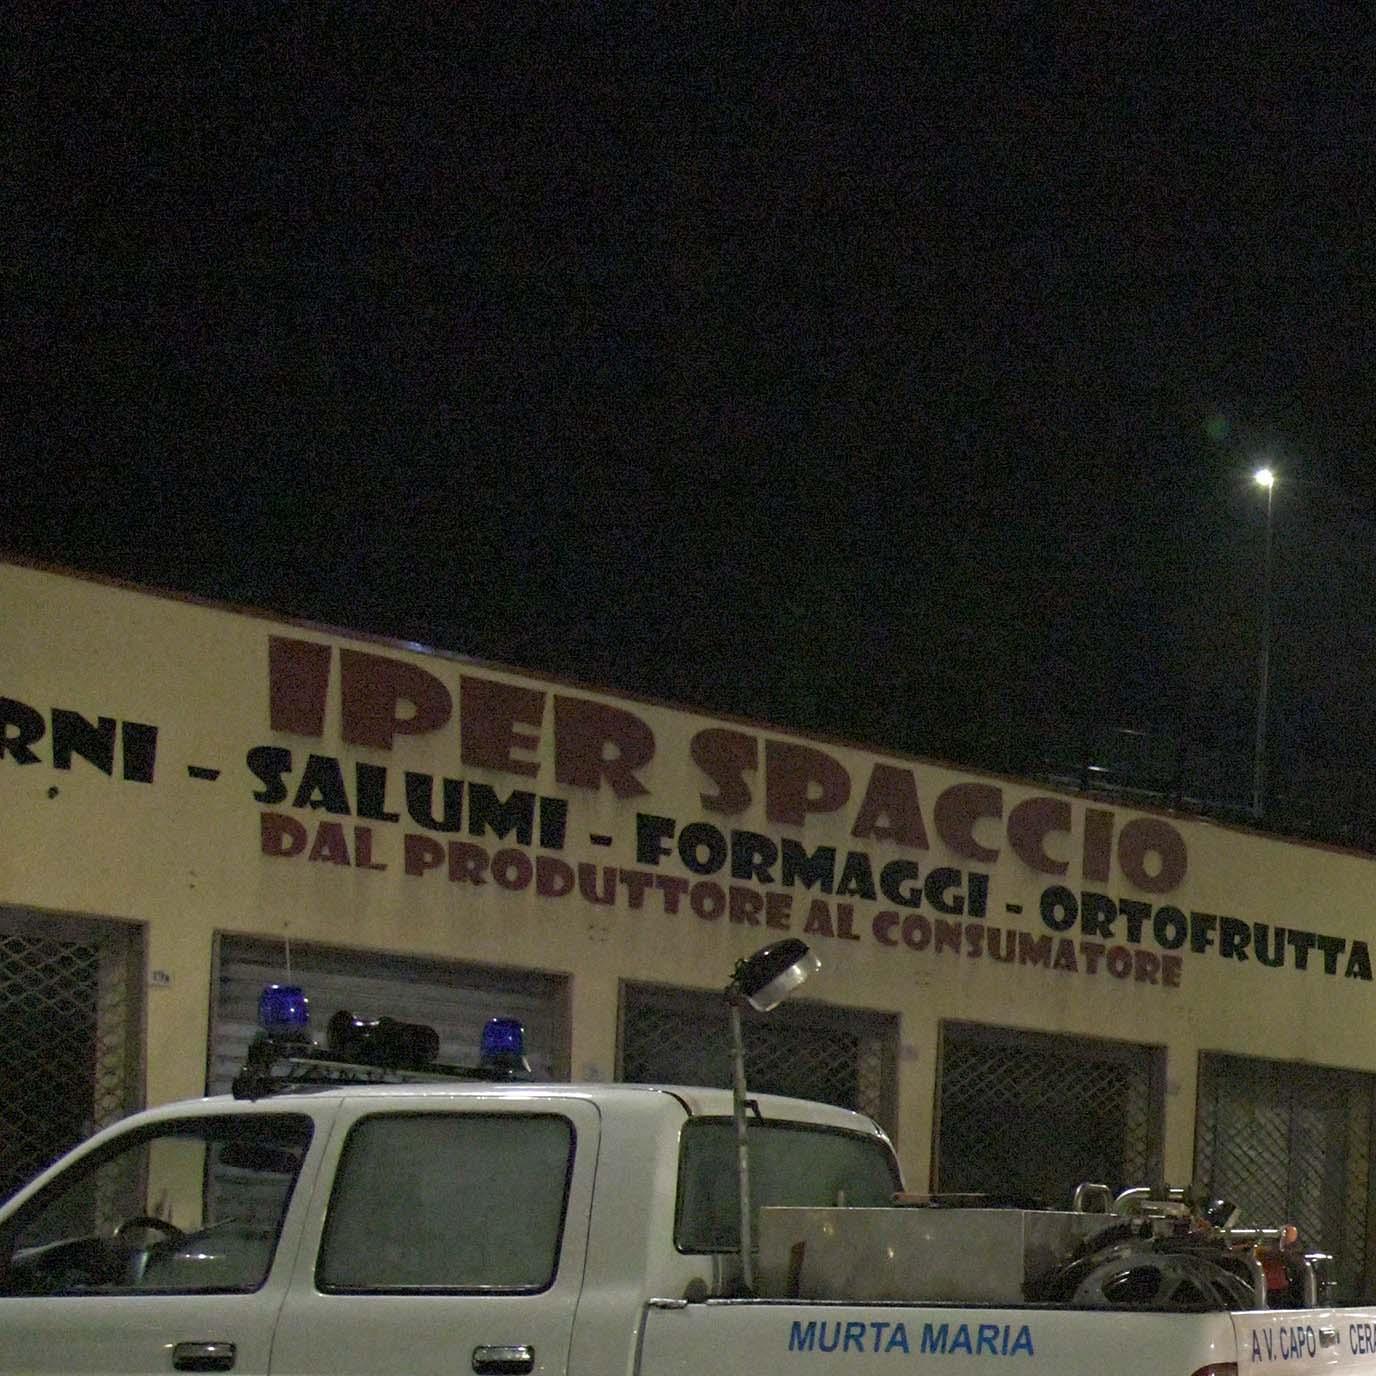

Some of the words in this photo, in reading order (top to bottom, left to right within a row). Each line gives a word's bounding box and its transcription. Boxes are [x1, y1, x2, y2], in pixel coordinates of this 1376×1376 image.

[268, 635, 655, 800] IPER
[690, 729, 1187, 893] SPACCIO
[246, 746, 567, 849] SALUMI
[636, 813, 989, 917] FORMAGGI
[1040, 885, 1373, 980] ORTOFRUTTA
[261, 812, 387, 871] DAL
[404, 833, 792, 929] PRODUTTORE
[804, 906, 859, 941] AL
[872, 911, 1183, 988] CONSUMATORE
[788, 1320, 909, 1354] MURTA
[920, 1323, 1034, 1356] MARIA
[1280, 1326, 1316, 1360] CAPO
